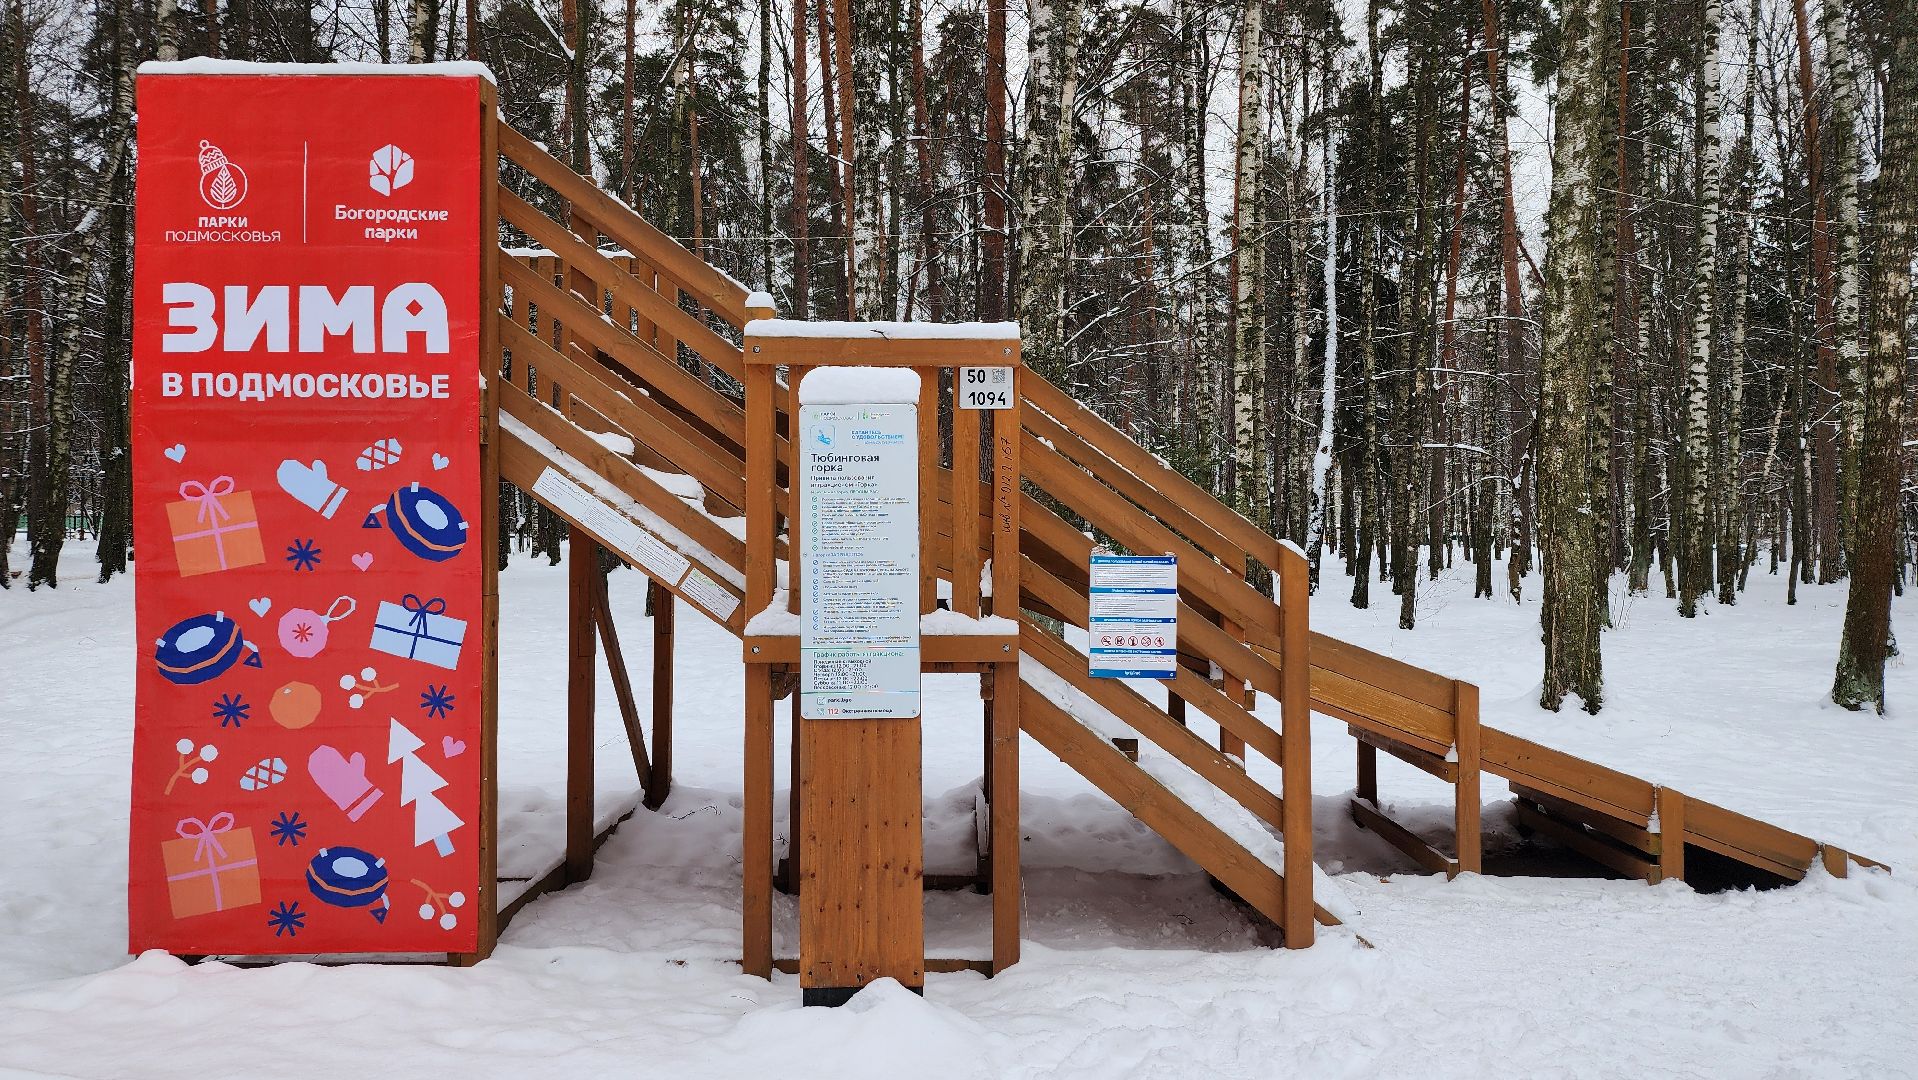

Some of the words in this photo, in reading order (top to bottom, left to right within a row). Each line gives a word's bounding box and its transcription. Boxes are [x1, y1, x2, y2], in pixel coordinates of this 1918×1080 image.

[335, 204, 449, 223] Богородские
[198, 216, 248, 228] ПАРКИ
[165, 230, 281, 242] ПОДМОСКОВЬЯ
[364, 226, 418, 242] парки
[162, 282, 450, 353] ЗИМА
[967, 369, 986, 383] 50
[162, 373, 183, 397] В
[191, 373, 450, 401] ПОДМОСКОВЬЕ
[968, 391, 1006, 405] 1094
[810, 453, 880, 462] Тюбинговая
[811, 464, 843, 474] горка
